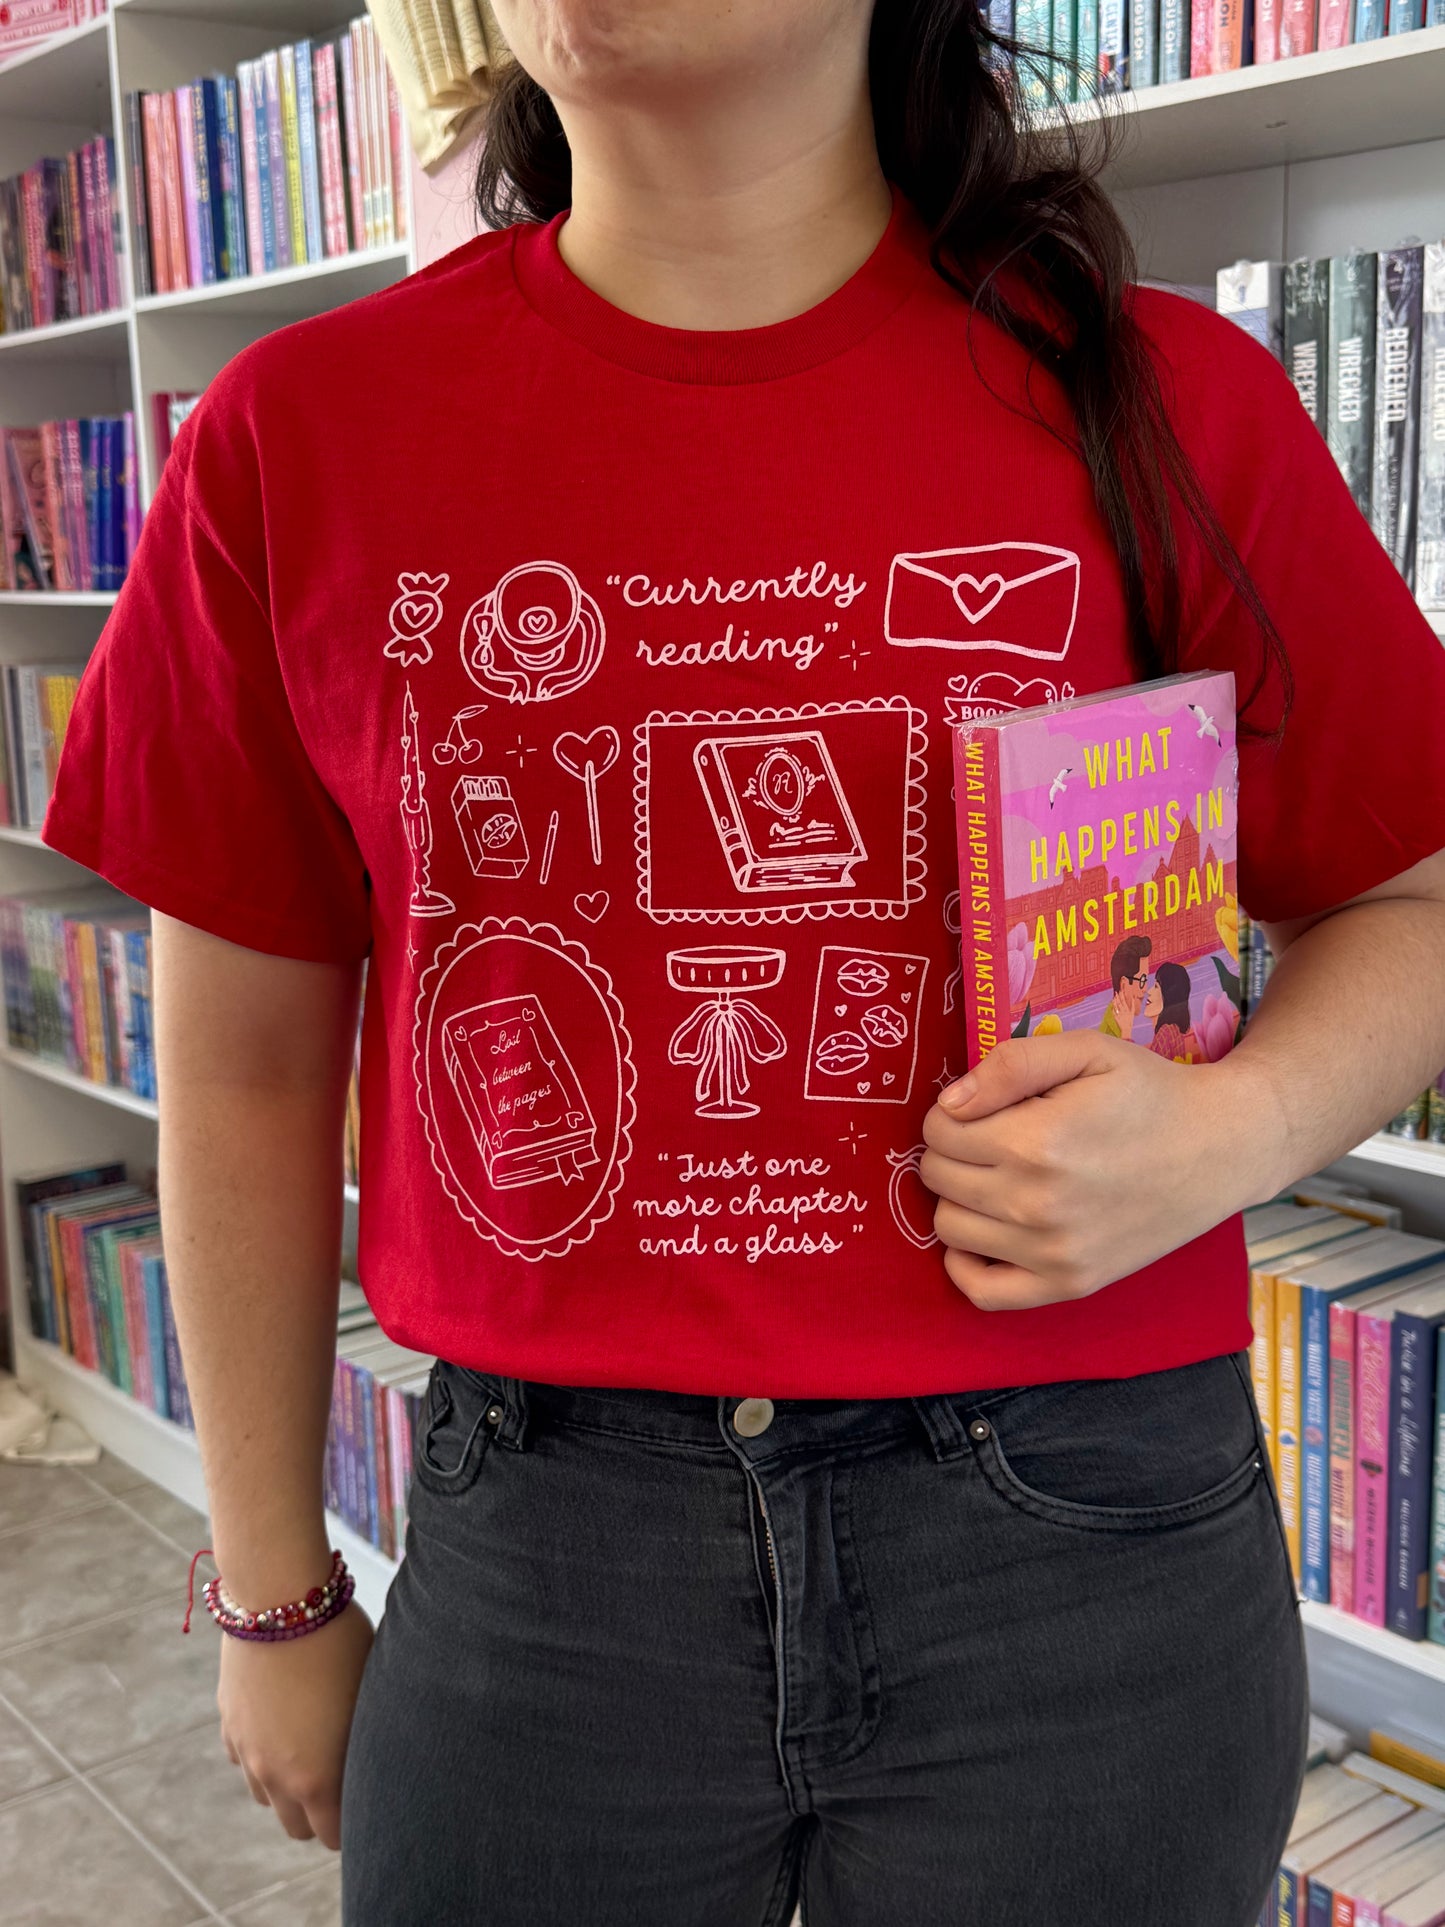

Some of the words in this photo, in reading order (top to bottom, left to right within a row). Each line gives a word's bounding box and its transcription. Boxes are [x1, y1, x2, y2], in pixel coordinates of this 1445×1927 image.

[1134, 0, 1145, 60] GUSON
[1338, 337, 1362, 423] WRECKED
[1384, 327, 1408, 422] REDEEMED
[961, 705, 1005, 720] BOO
[964, 741, 985, 804] WHAT
[1083, 726, 1173, 789] WHAT
[967, 810, 990, 914] HAPPENS
[1029, 800, 1182, 883] HAPPENS
[1196, 787, 1223, 834] IN
[972, 916, 992, 943] IN
[1032, 858, 1225, 960] AMSTERDAM
[973, 947, 997, 1060] AMSTERDA
[492, 1060, 532, 1085] between
[497, 1094, 511, 1115] the
[511, 1084, 552, 1116] pages
[765, 1157, 831, 1176] one
[633, 1194, 722, 1217] more
[729, 1184, 867, 1223] chapter
[639, 1224, 707, 1257] and
[713, 1236, 738, 1254] a
